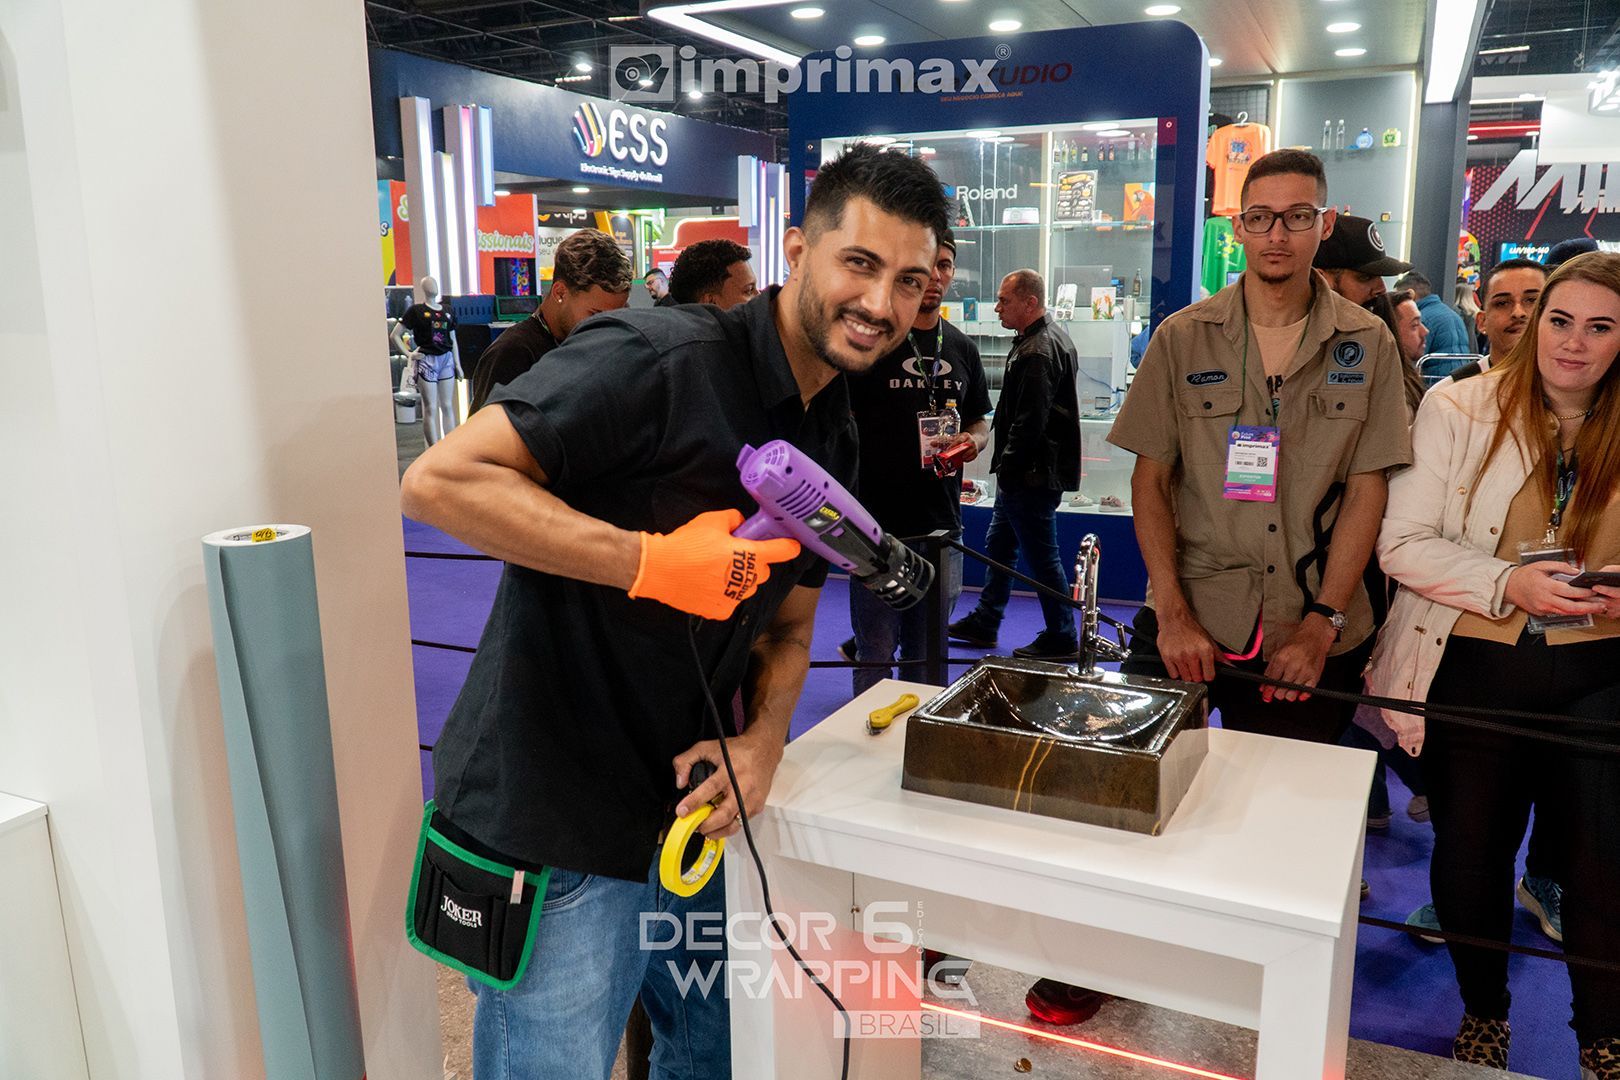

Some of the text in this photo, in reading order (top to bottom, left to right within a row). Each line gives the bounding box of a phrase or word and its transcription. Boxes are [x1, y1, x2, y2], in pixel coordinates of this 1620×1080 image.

[956, 183, 1018, 201] Roland
[889, 378, 963, 391] OAKLEY
[724, 550, 746, 600] TOOLS
[440, 895, 482, 927] JOKER
